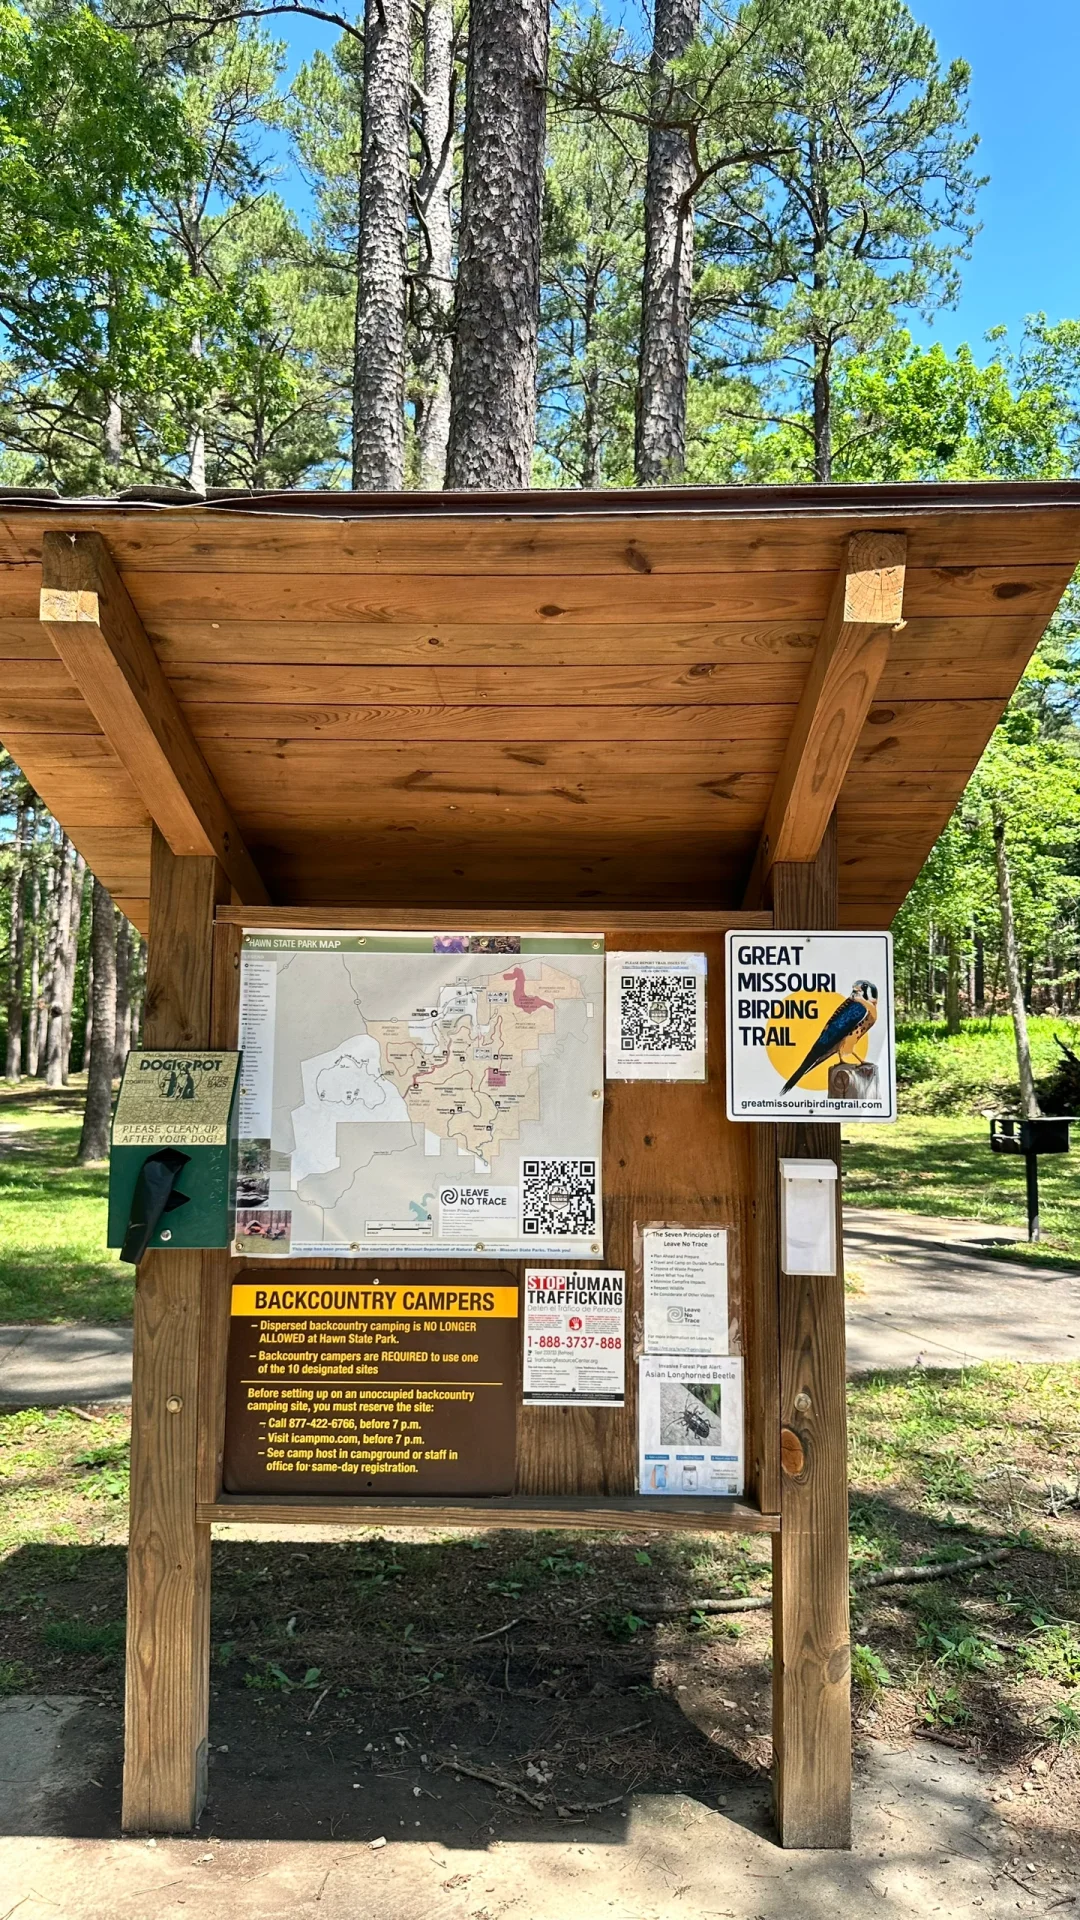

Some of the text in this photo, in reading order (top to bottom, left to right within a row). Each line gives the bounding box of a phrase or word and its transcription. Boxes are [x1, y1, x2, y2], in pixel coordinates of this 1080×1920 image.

[249, 939, 341, 948] HAWN STATE PARK MAP
[738, 946, 804, 966] GREAT
[738, 973, 835, 993] MISSOURI
[738, 999, 819, 1019] BIRDING
[739, 1026, 796, 1047] TRAIL
[741, 1100, 882, 1110] greatmissouribirdingtrail.com
[122, 1135, 154, 1143] AFTER
[460, 1188, 489, 1198] LEAVE
[461, 1197, 507, 1206] NO TRACE
[528, 1276, 622, 1291] STOP HUMAN
[255, 1291, 494, 1311] BACKCOUNTRY CAMPERS
[528, 1291, 622, 1305] TRAFFICKING
[260, 1321, 476, 1333] Dispersed backcountry camping is NO LONGER
[259, 1334, 399, 1344] ALLOWED at Hawn State Park.
[528, 1336, 622, 1349] 1-888-3737-888
[259, 1352, 478, 1362] Backcountry campers are REQUIRED to use one
[258, 1364, 378, 1376] of the 10 designated sites
[668, 1372, 710, 1380] Longhorned
[248, 1389, 474, 1402] Before setting up on an unoccupied backcountry
[247, 1402, 434, 1413] camping site, you must reserve the site:
[269, 1419, 421, 1431] Call 877-422-6766, before 7 p.m.
[268, 1434, 424, 1446] Visit icampmo.com, before 7 p.m.
[267, 1448, 458, 1461] See camp host in campground or staff in
[267, 1462, 418, 1474] office for same-day registration.
